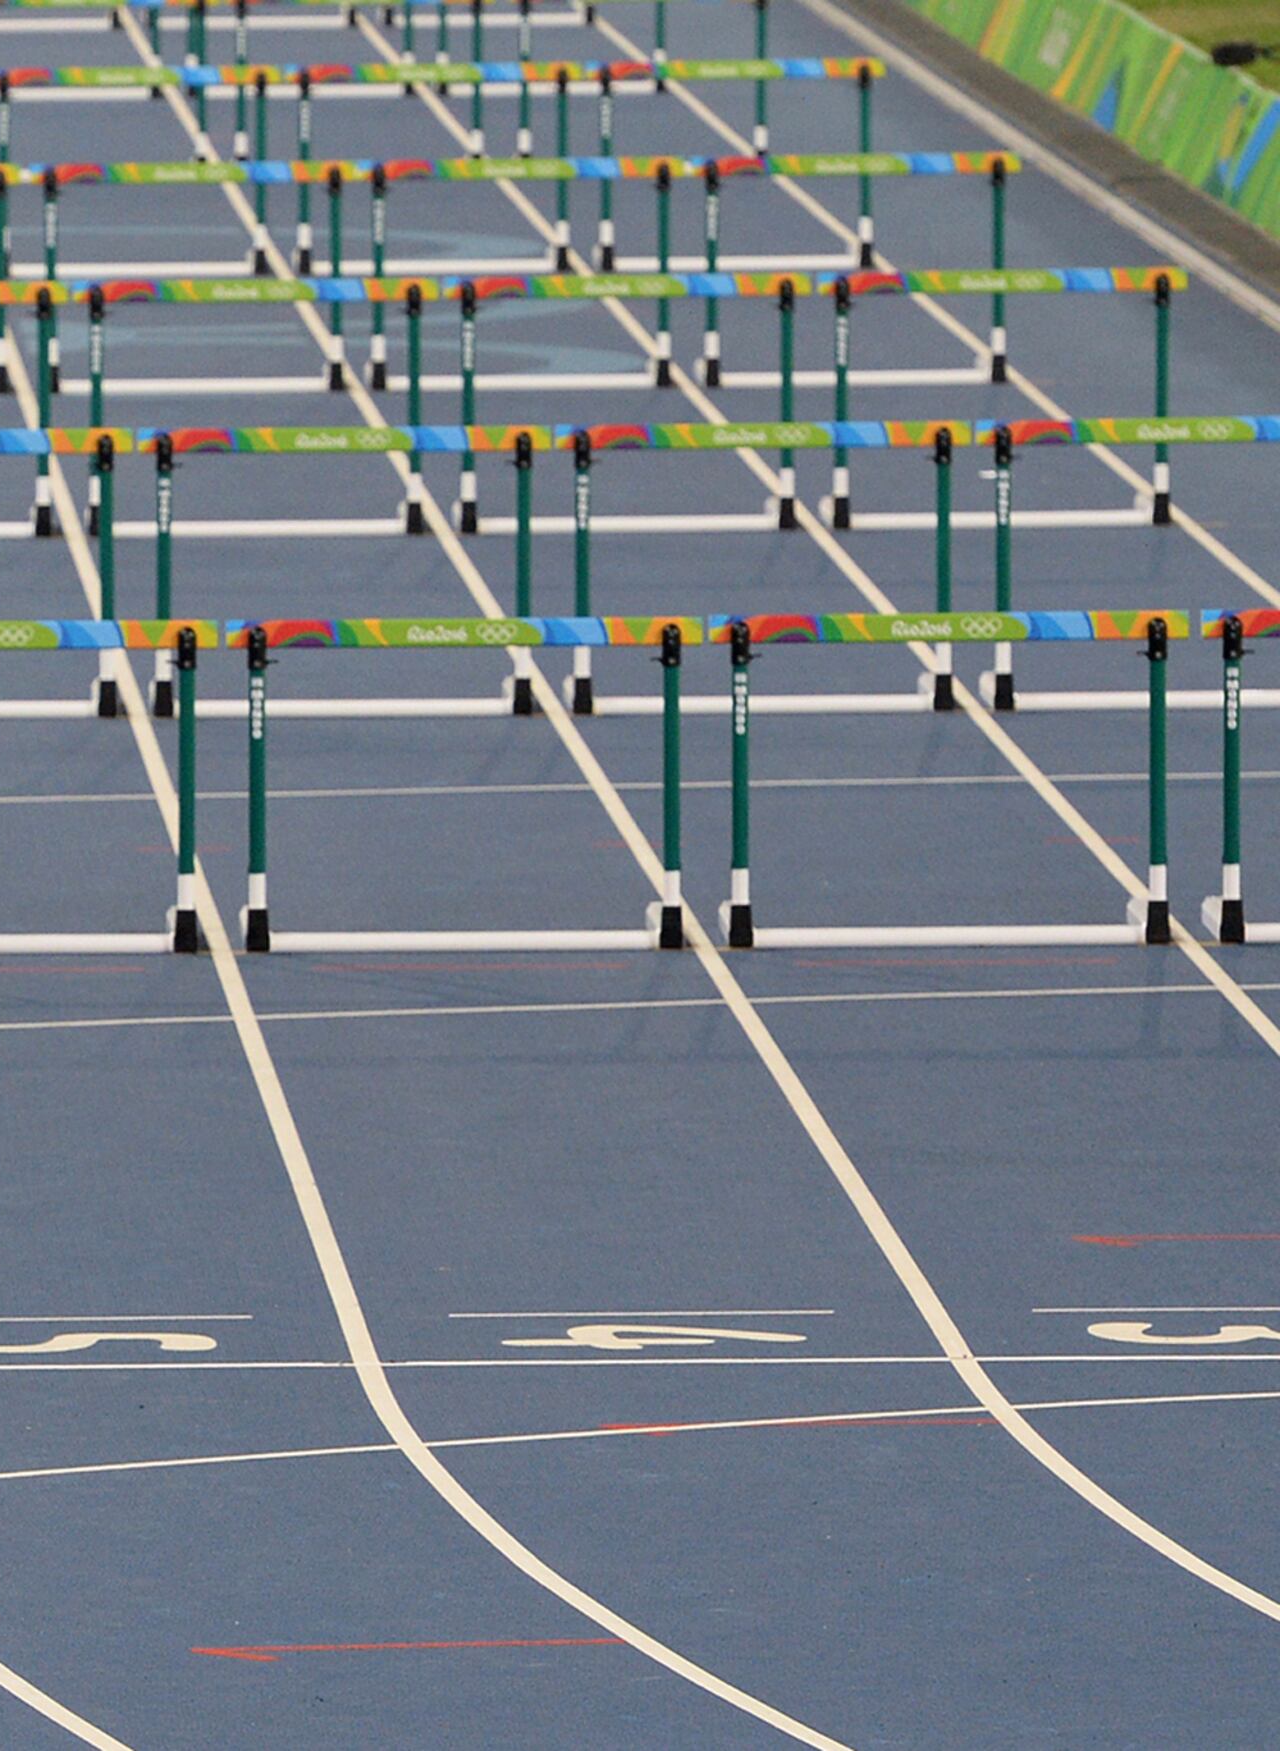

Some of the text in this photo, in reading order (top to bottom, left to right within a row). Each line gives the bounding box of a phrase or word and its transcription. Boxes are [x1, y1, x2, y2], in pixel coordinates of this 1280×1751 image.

[407, 625, 468, 641] Rio2016
[891, 620, 952, 637] Rio2016
[501, 1324, 807, 1350] 4
